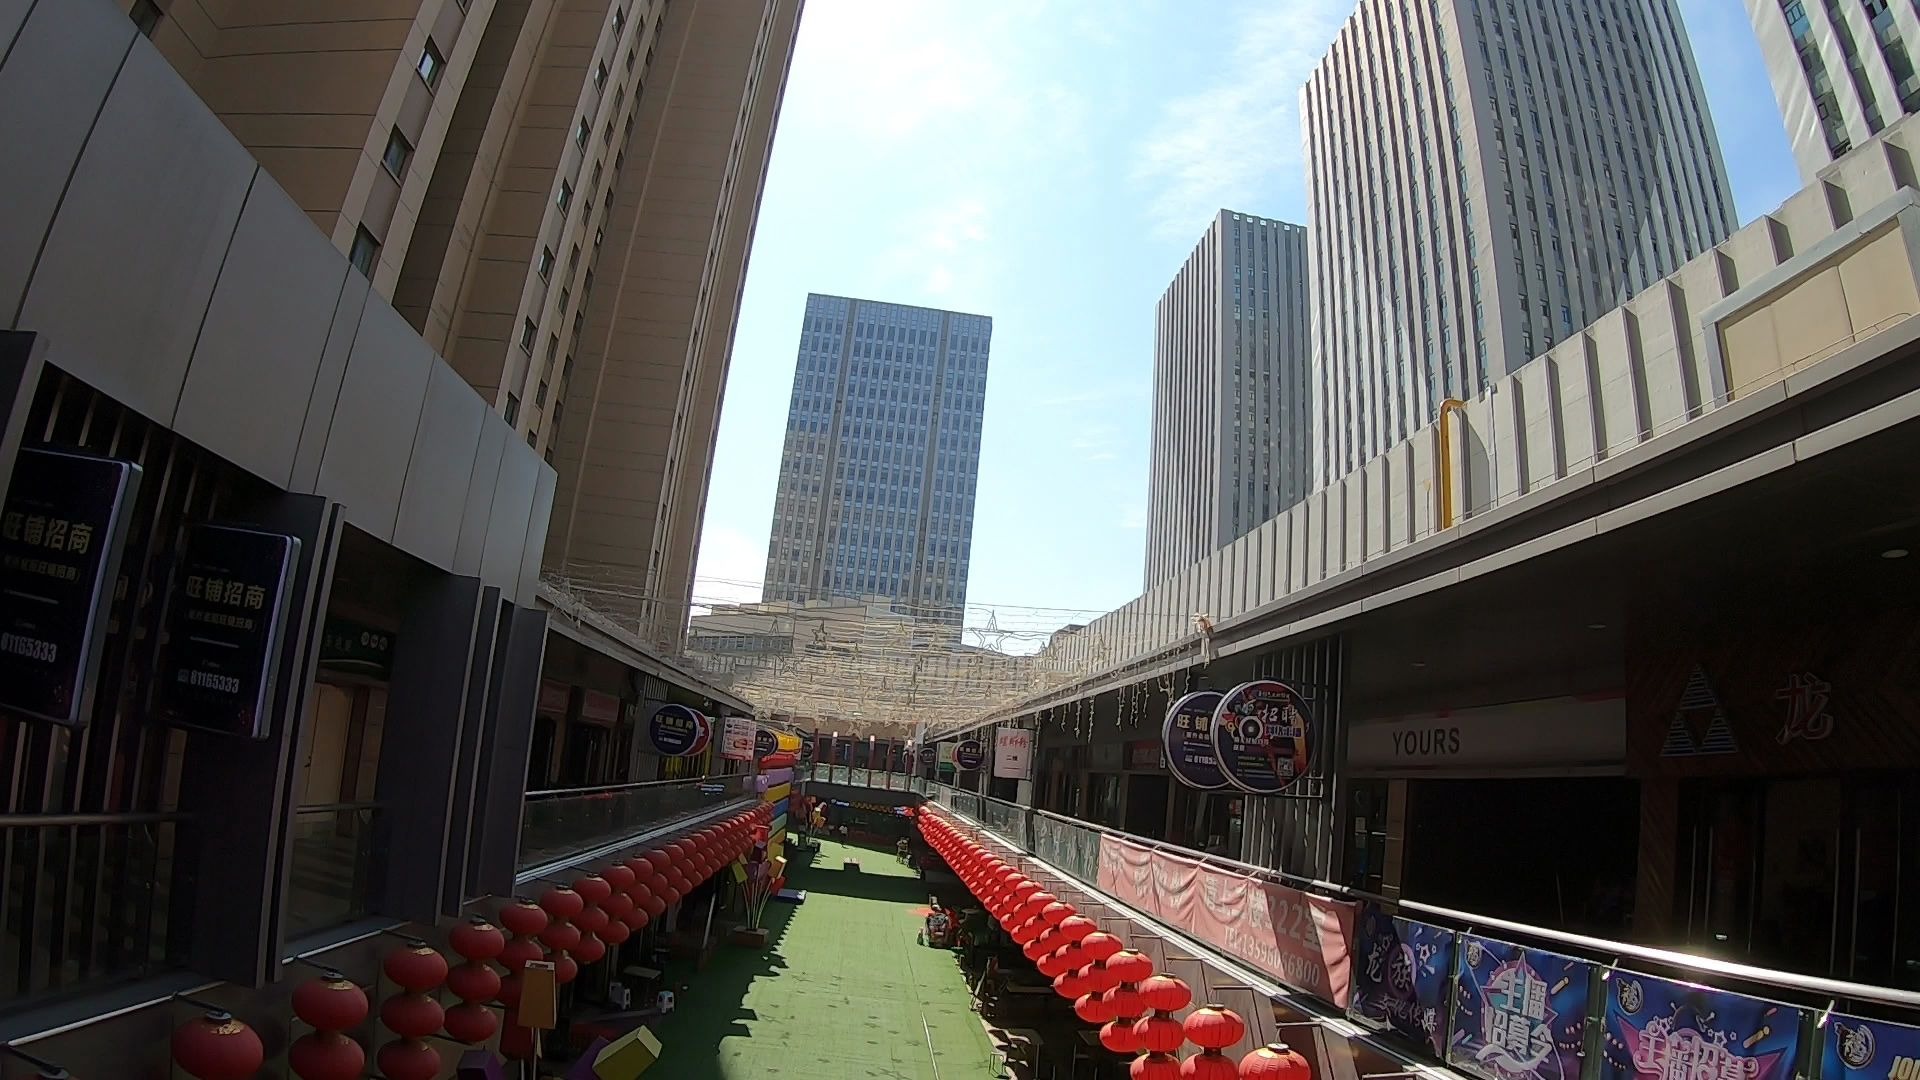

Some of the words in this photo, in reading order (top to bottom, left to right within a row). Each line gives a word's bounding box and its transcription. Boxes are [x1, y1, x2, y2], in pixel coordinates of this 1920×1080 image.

[2, 511, 95, 555] 旺铺招商
[185, 575, 267, 610] 旺铺招商
[1393, 727, 1461, 757] YOURS
